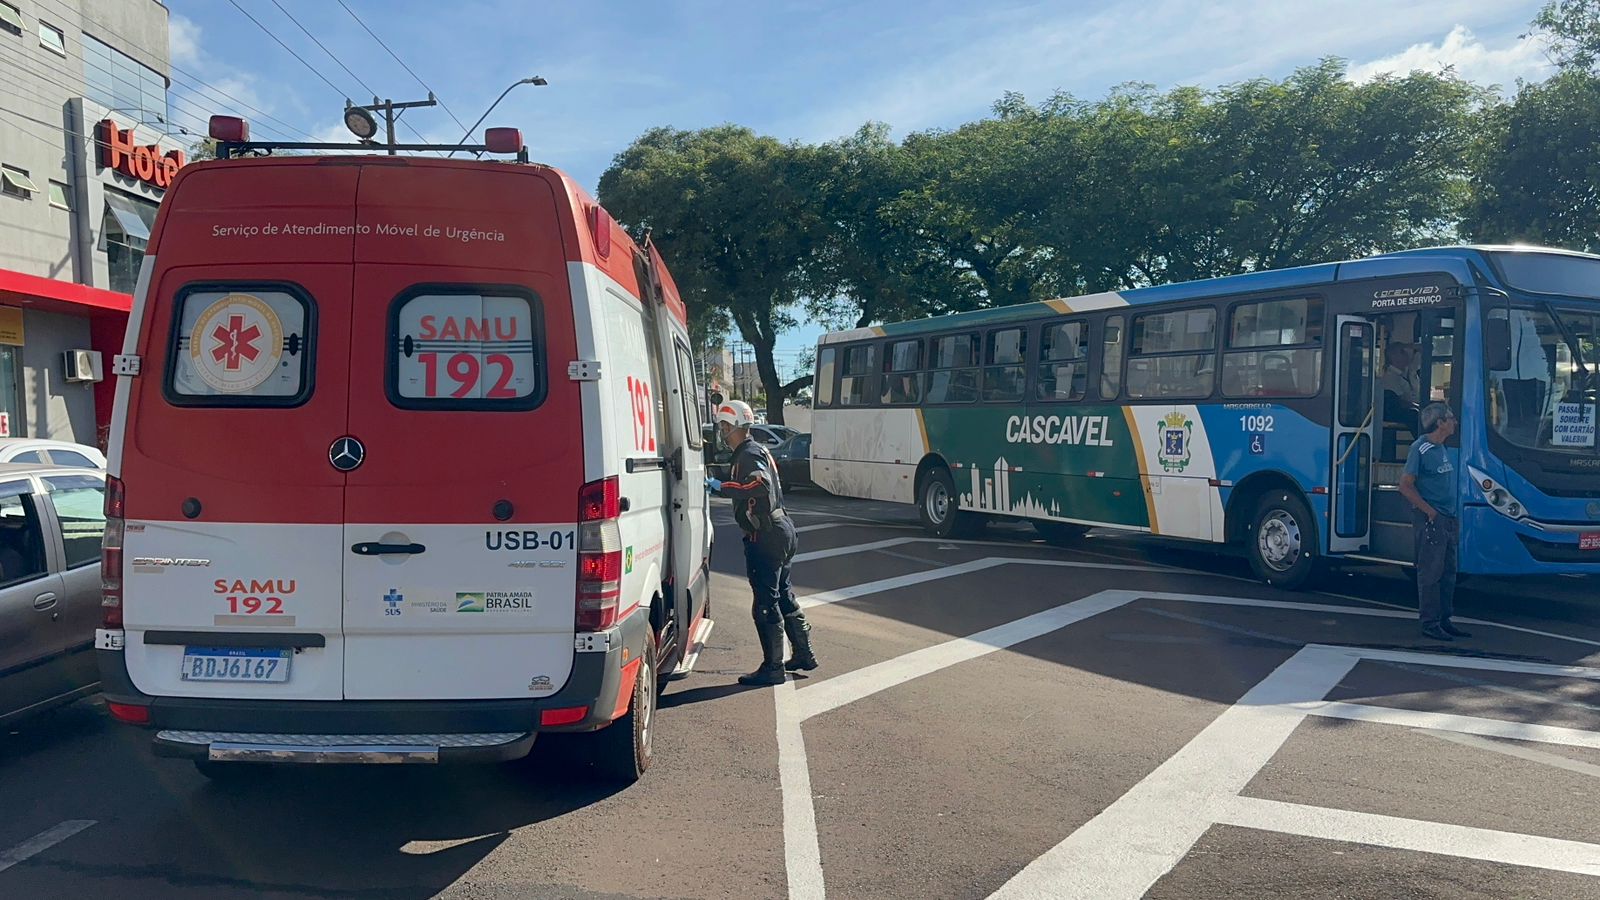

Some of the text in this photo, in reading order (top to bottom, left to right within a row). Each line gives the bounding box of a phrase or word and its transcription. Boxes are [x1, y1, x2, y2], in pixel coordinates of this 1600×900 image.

[212, 222, 505, 243] Serviço de Atendimento Móvel de Urgência
[1372, 294, 1442, 308] PORTA DE SERVIÇO
[419, 315, 517, 342] SAMU
[418, 351, 517, 399] 192
[627, 375, 655, 452] 192
[1558, 405, 1592, 415] PASSAEM
[1006, 415, 1114, 447] CASCAVEL
[1239, 415, 1274, 432] 1092
[1554, 424, 1595, 434] COM CARTÃO
[485, 530, 575, 551] USB-01
[132, 557, 210, 567] SPRINTER
[213, 579, 296, 594] SAMU
[226, 596, 284, 614] 192
[385, 608, 401, 616] SUS
[486, 598, 532, 609] BRASIL
